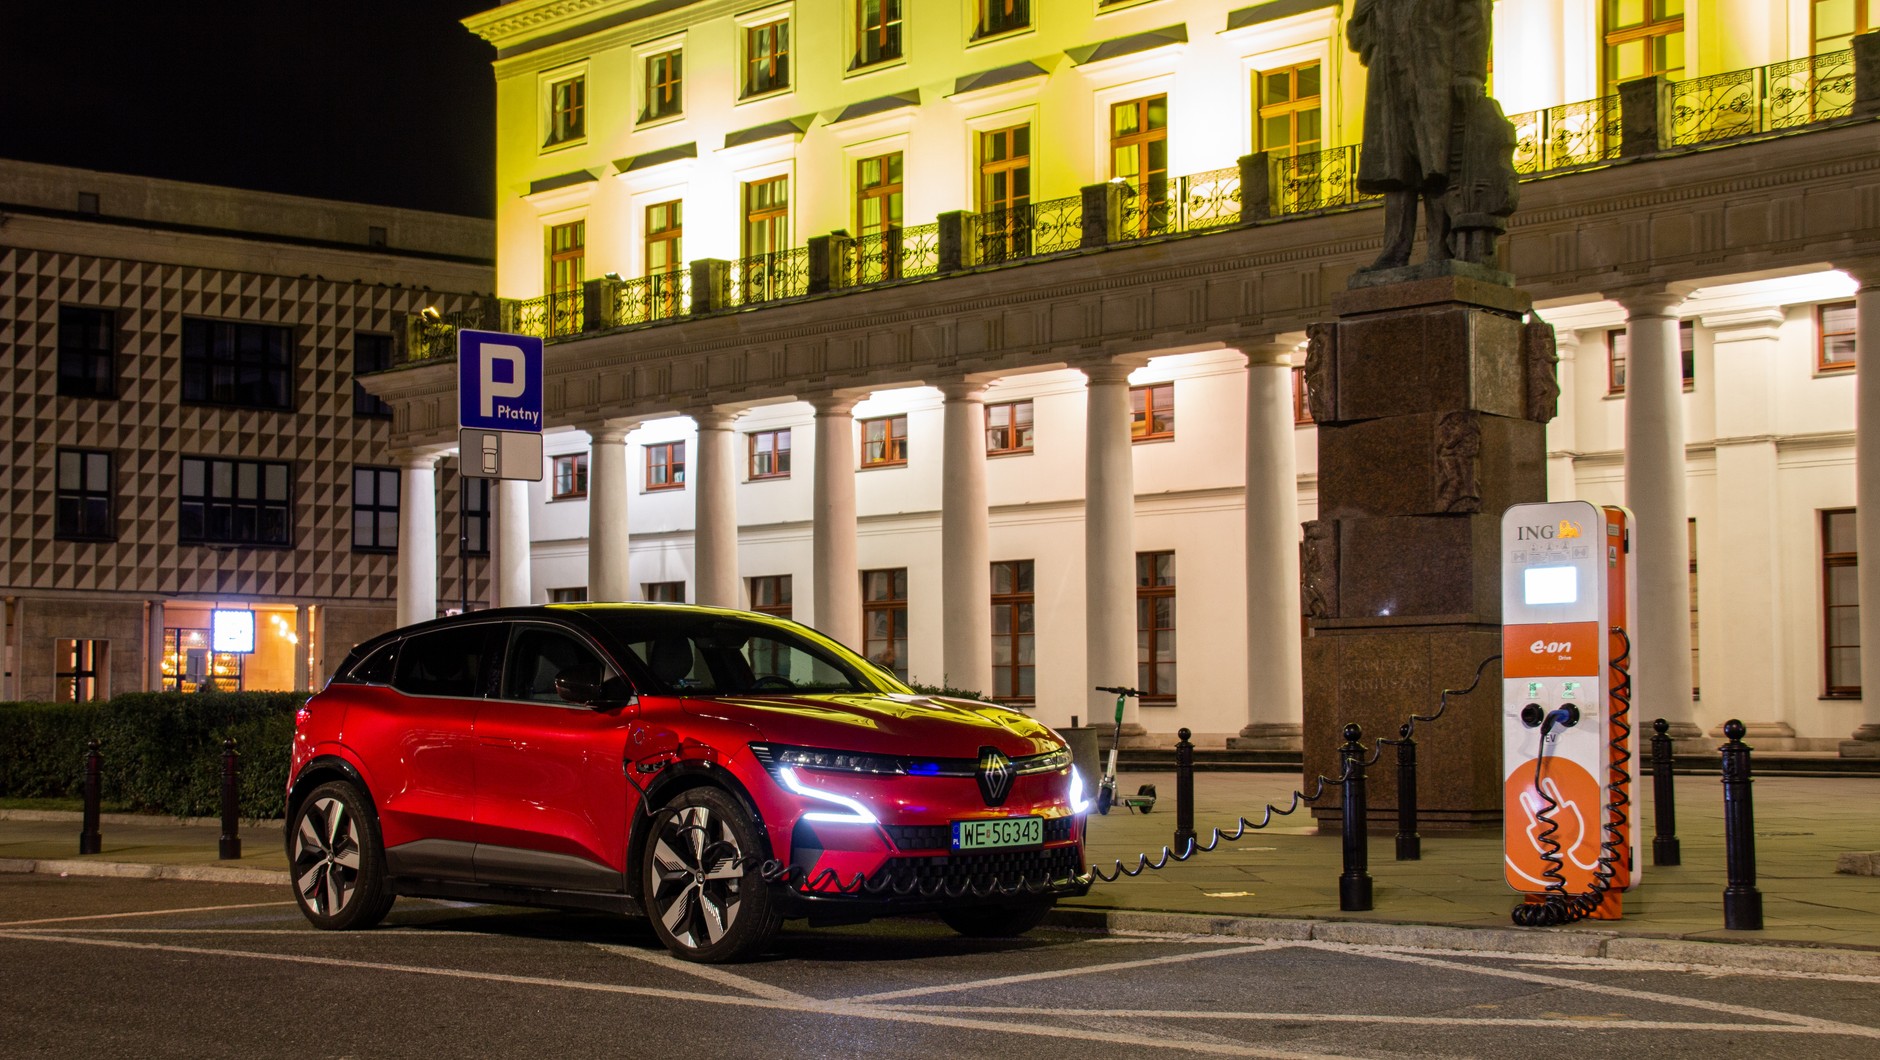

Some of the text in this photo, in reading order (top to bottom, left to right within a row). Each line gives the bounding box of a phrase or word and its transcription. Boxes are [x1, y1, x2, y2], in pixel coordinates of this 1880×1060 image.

[480, 343, 525, 418] P
[497, 405, 539, 425] Płatny
[1517, 524, 1554, 541] ING
[1545, 733, 1557, 743] EV
[964, 820, 1039, 846] WE 5G343
